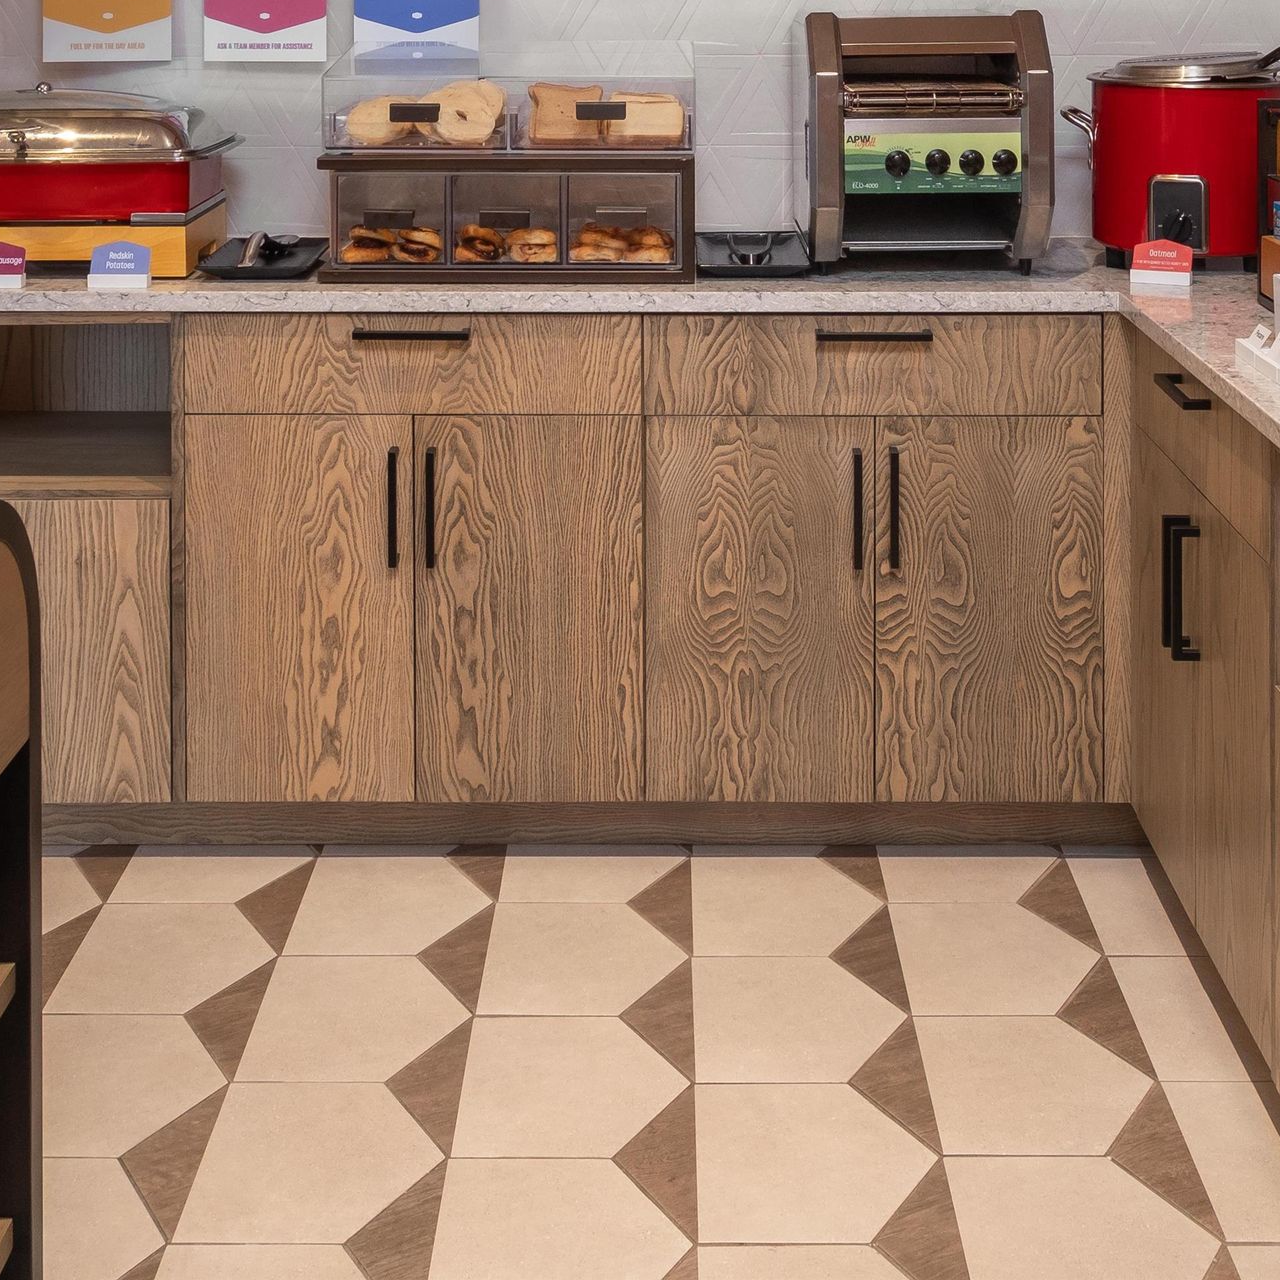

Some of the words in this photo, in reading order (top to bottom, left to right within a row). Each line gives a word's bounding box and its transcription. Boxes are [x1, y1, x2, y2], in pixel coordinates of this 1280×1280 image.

[217, 42, 227, 50] ASK
[233, 42, 248, 50] TEAM
[249, 42, 271, 50] MEMBER
[272, 42, 281, 50] FOR
[282, 42, 313, 50] ASSISTANCE
[109, 251, 134, 260] Redskin
[1149, 248, 1177, 258] Oatmeal
[105, 260, 135, 270] Potatoes
